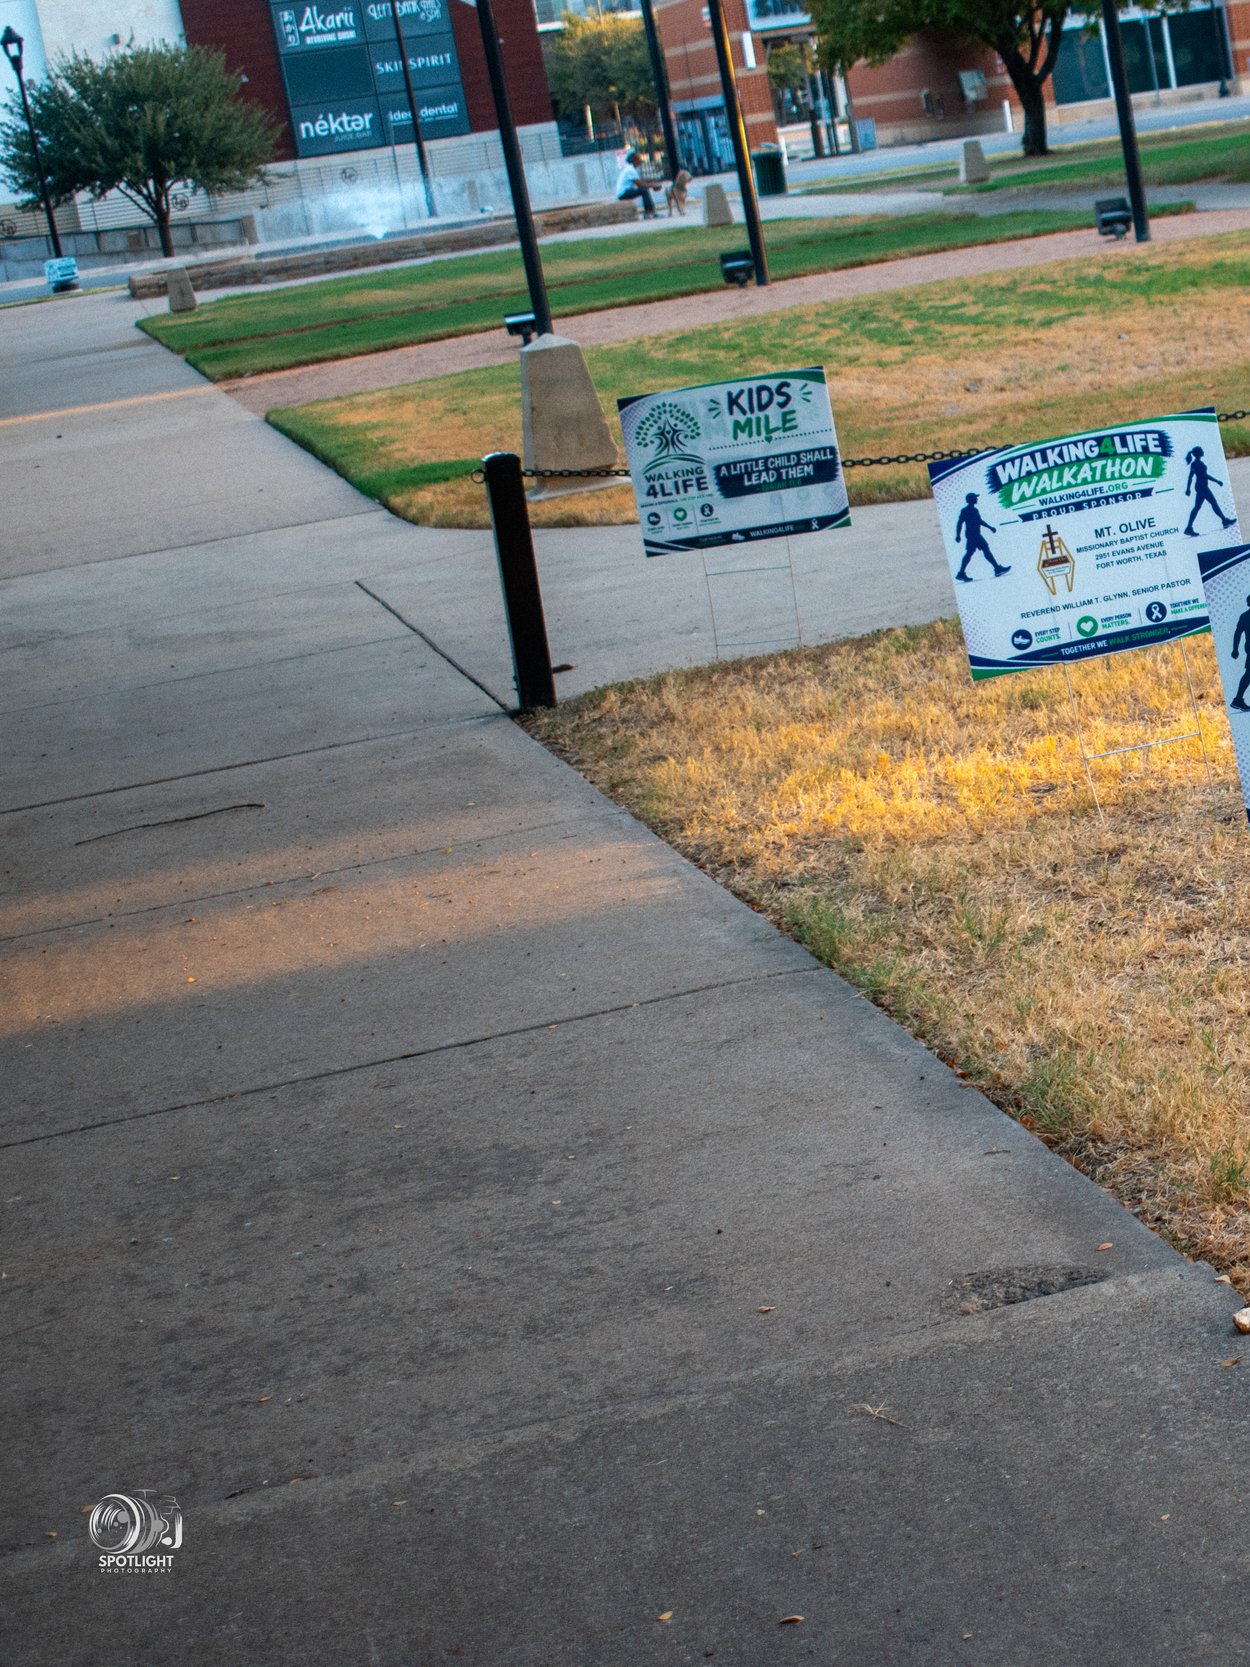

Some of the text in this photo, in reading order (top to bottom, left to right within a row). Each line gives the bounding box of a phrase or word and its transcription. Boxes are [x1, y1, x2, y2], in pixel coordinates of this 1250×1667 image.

[409, 53, 451, 70] SPIRIT
[389, 110, 412, 122] ide
[420, 102, 458, 117] dental
[727, 381, 792, 416] KIDS
[732, 409, 799, 441] MILE
[721, 449, 833, 477] A LITTLE CHILD SHALL
[996, 433, 1162, 484] WALKING4LIFE
[644, 466, 704, 483] WALKING
[744, 464, 814, 486] LEAD THEM
[1011, 456, 1153, 503] WALKATHON
[646, 476, 709, 498] 4LIFE
[1039, 482, 1128, 507] WALKING4LIFE.ORG
[1033, 492, 1142, 521] PROUD SPONSOR
[1094, 517, 1156, 538] MT. OLIVE
[1076, 527, 1179, 553] MISSIONARY BAPTIST CHURCH
[1112, 547, 1135, 557] EVANS
[1137, 541, 1164, 552] AVENUE
[1096, 550, 1167, 570] FORT WORTH, TEXAS
[1020, 578, 1191, 620] REVEREND WILLIAM T. GLYNN, SENIOR PASTOR
[1101, 612, 1132, 623] EVERY PERSON
[1035, 627, 1060, 637] EVERY STEP
[1061, 642, 1096, 656] TOGETHER
[1096, 640, 1108, 649] WE
[1109, 635, 1130, 646] WALK
